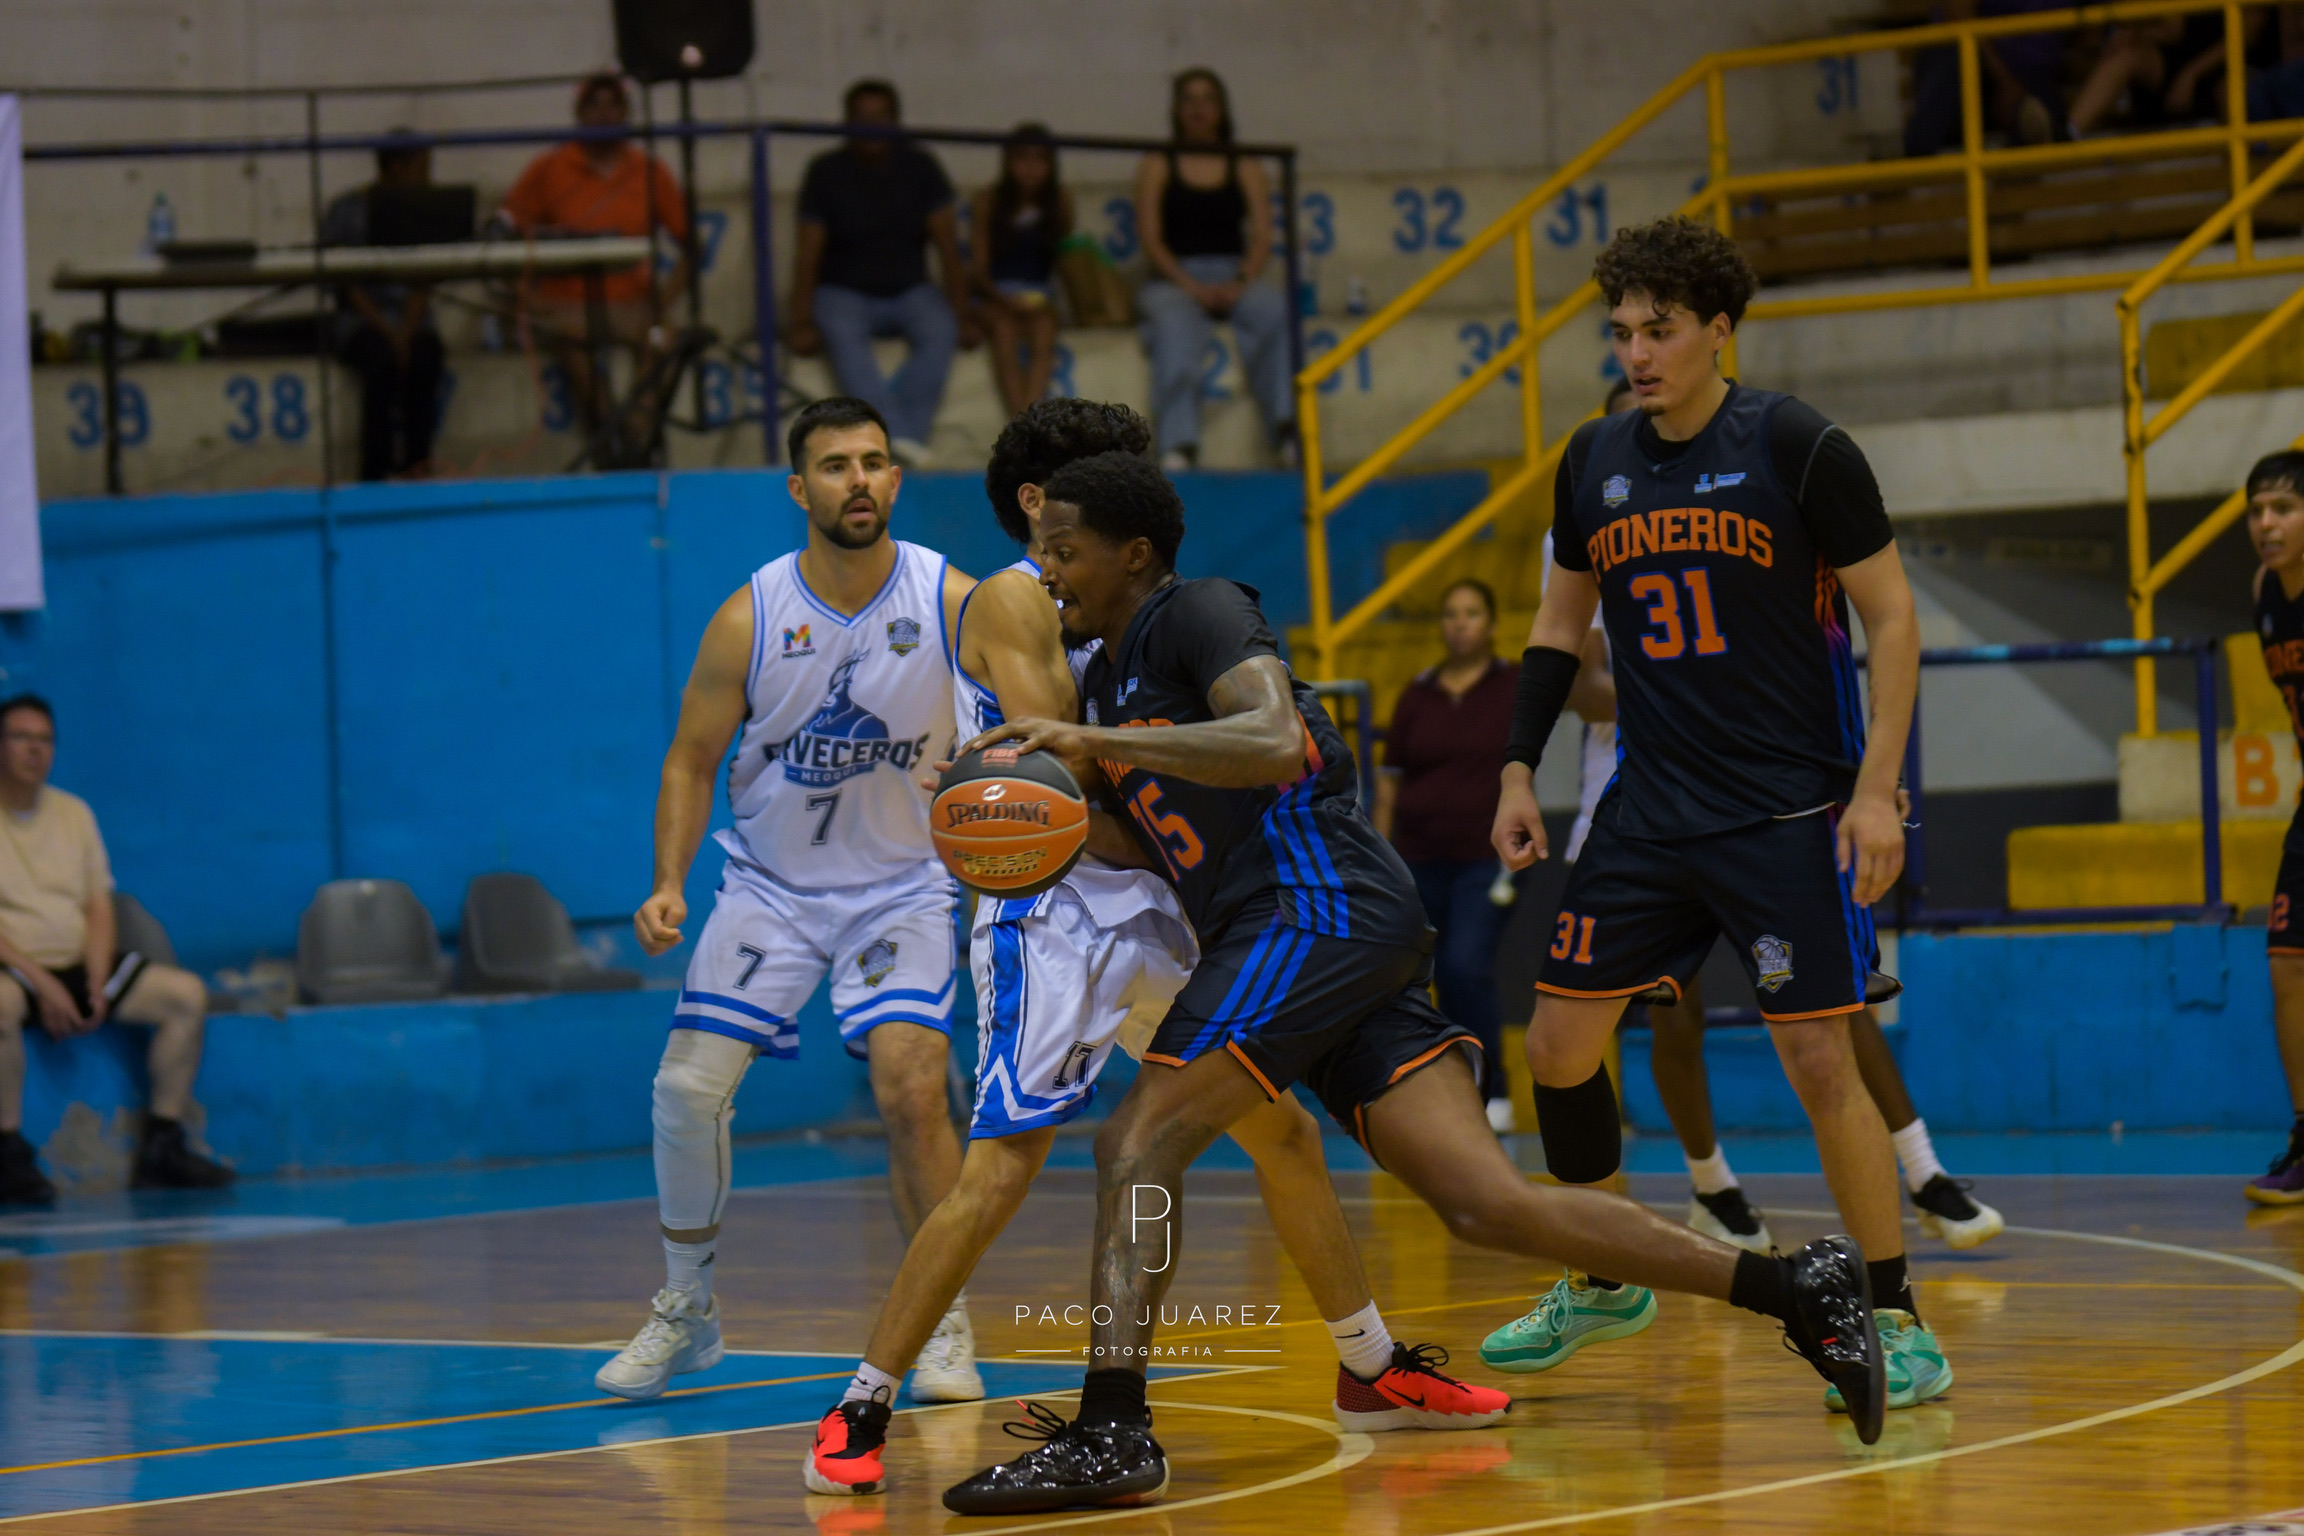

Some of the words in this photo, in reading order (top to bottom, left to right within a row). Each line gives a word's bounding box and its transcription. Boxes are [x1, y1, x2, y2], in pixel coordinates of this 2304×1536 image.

[1104, 200, 1139, 258] 3
[1394, 186, 1465, 253] 32
[1546, 184, 1610, 246] 31
[226, 373, 310, 444] 38
[1587, 507, 1774, 584] PIONEROS
[1627, 566, 1729, 661] 31
[782, 648, 816, 659] MEOQUI
[801, 766, 858, 782] MEOQUI
[806, 787, 842, 846] 7
[947, 801, 1049, 828] SPALDING
[953, 846, 1048, 867] PRECISION
[733, 941, 767, 991] 7
[1550, 909, 1597, 966] 31
[1052, 1040, 1098, 1090] 17
